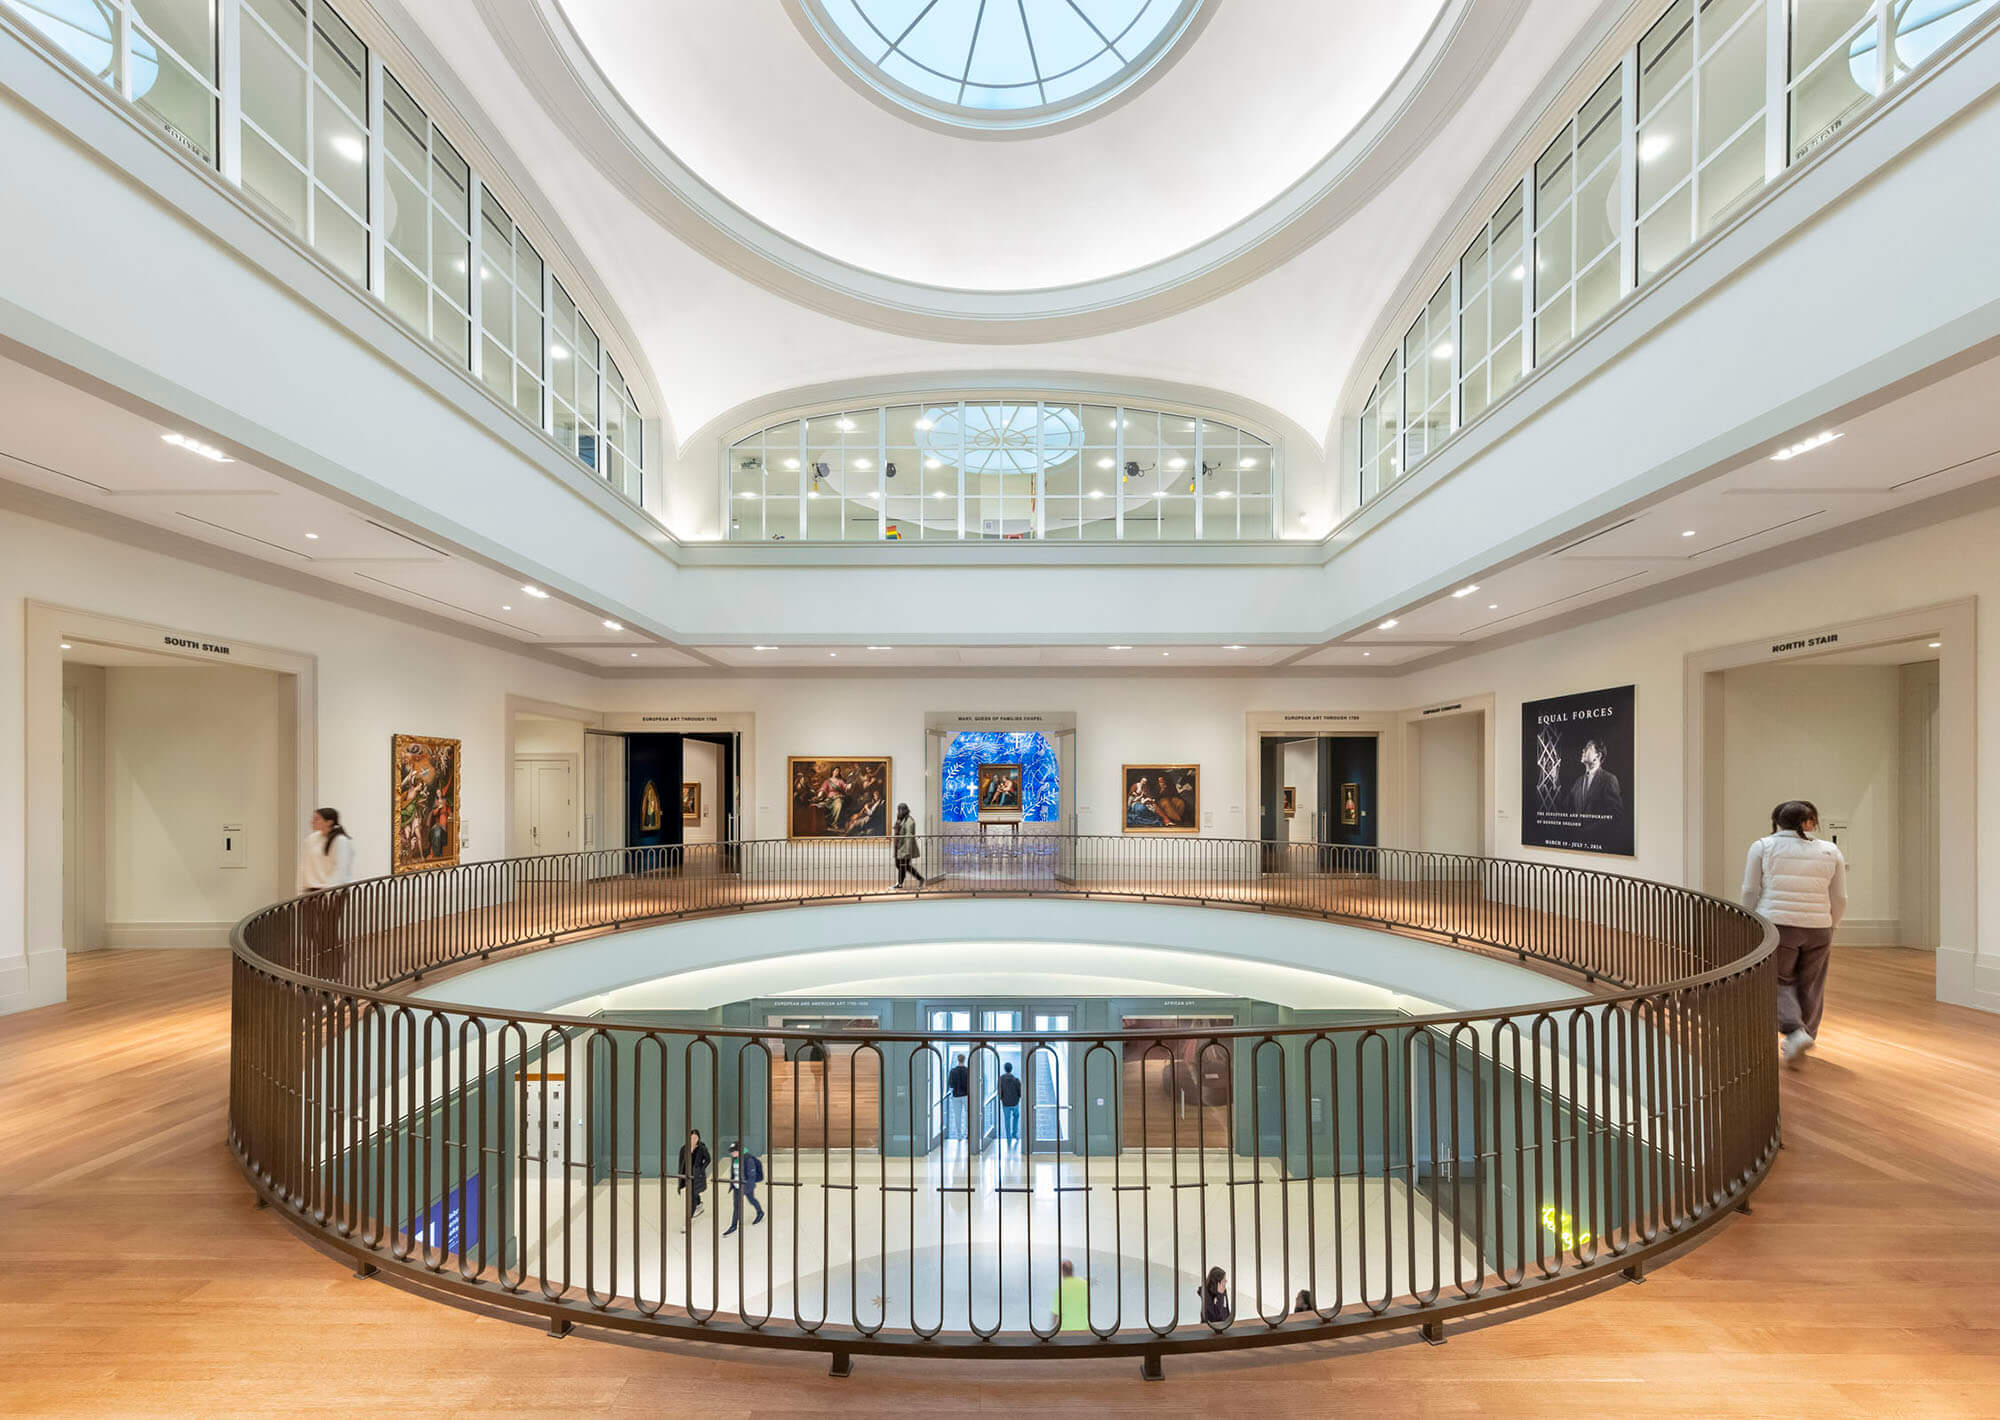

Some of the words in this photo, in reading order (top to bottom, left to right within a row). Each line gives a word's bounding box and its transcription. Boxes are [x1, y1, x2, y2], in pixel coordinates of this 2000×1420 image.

[164, 637, 199, 649] SOUTH
[202, 643, 230, 655] STAIR
[1772, 640, 1805, 653] NORTH
[1808, 634, 1838, 647] STAIR
[1538, 712, 1568, 725] EQUAL
[1572, 706, 1613, 720] FORCES
